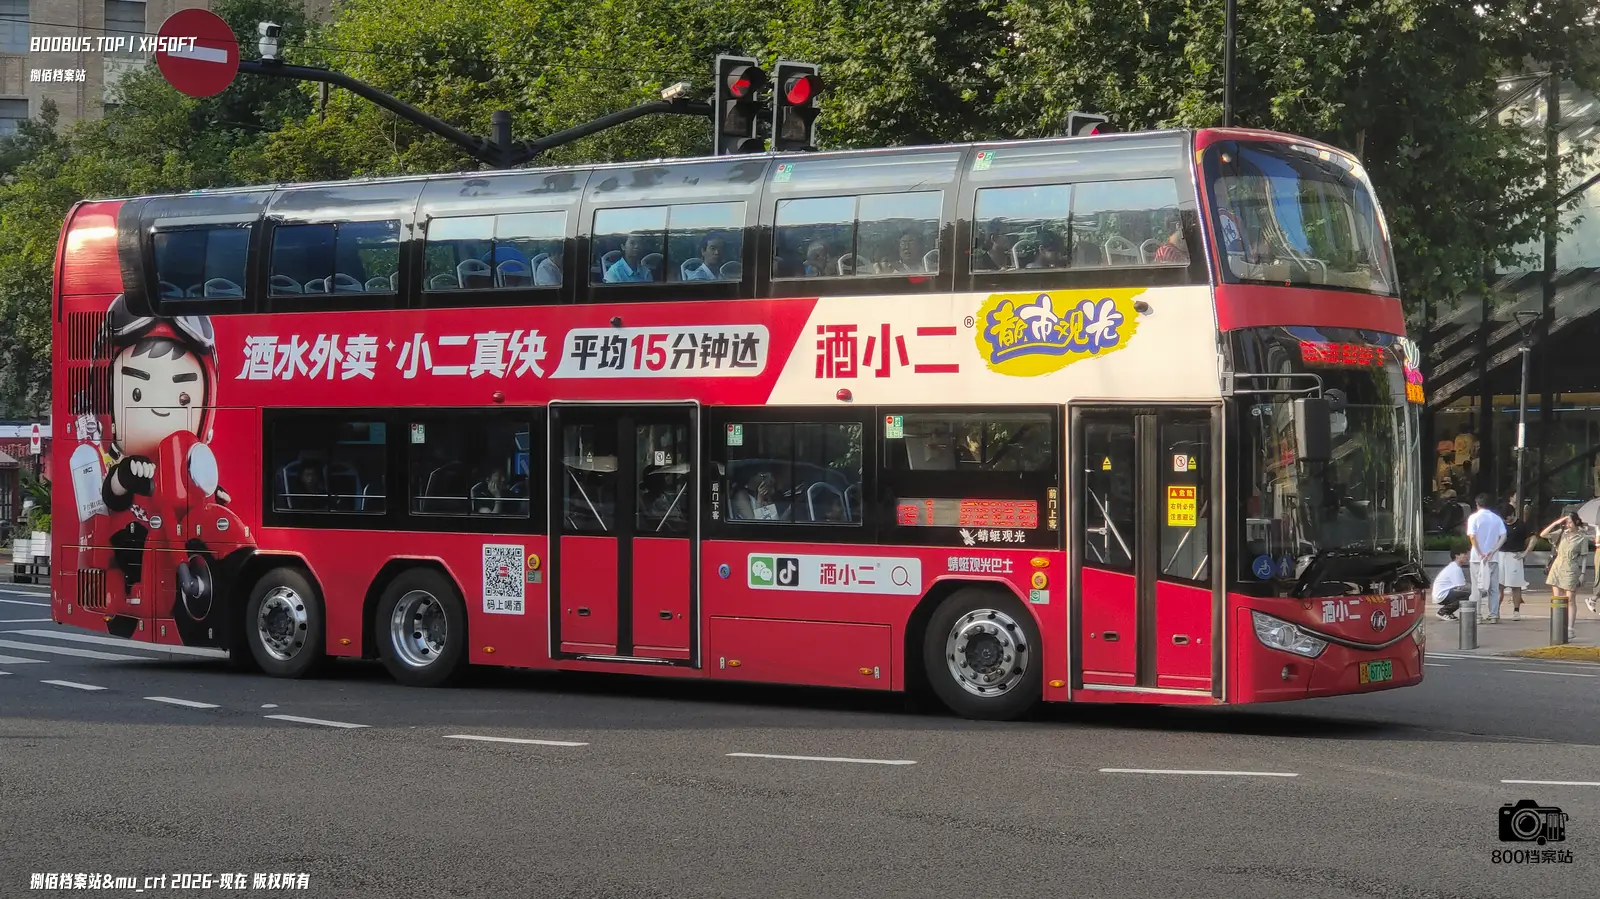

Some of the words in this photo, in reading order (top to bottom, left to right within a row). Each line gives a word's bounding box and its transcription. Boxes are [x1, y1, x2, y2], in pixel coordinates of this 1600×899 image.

[986, 294, 1124, 350] 都市观光
[234, 333, 380, 380] 酒水外卖
[395, 329, 549, 380] 小二真快
[570, 331, 761, 372] 平均15分钟达
[977, 529, 1026, 543] 蜻蜓观光
[947, 557, 1014, 574] 蜻蜓观光巴士
[487, 599, 522, 612] 码上喝酒
[1321, 599, 1361, 624] 酒小二
[1389, 594, 1416, 618] 酒小二
